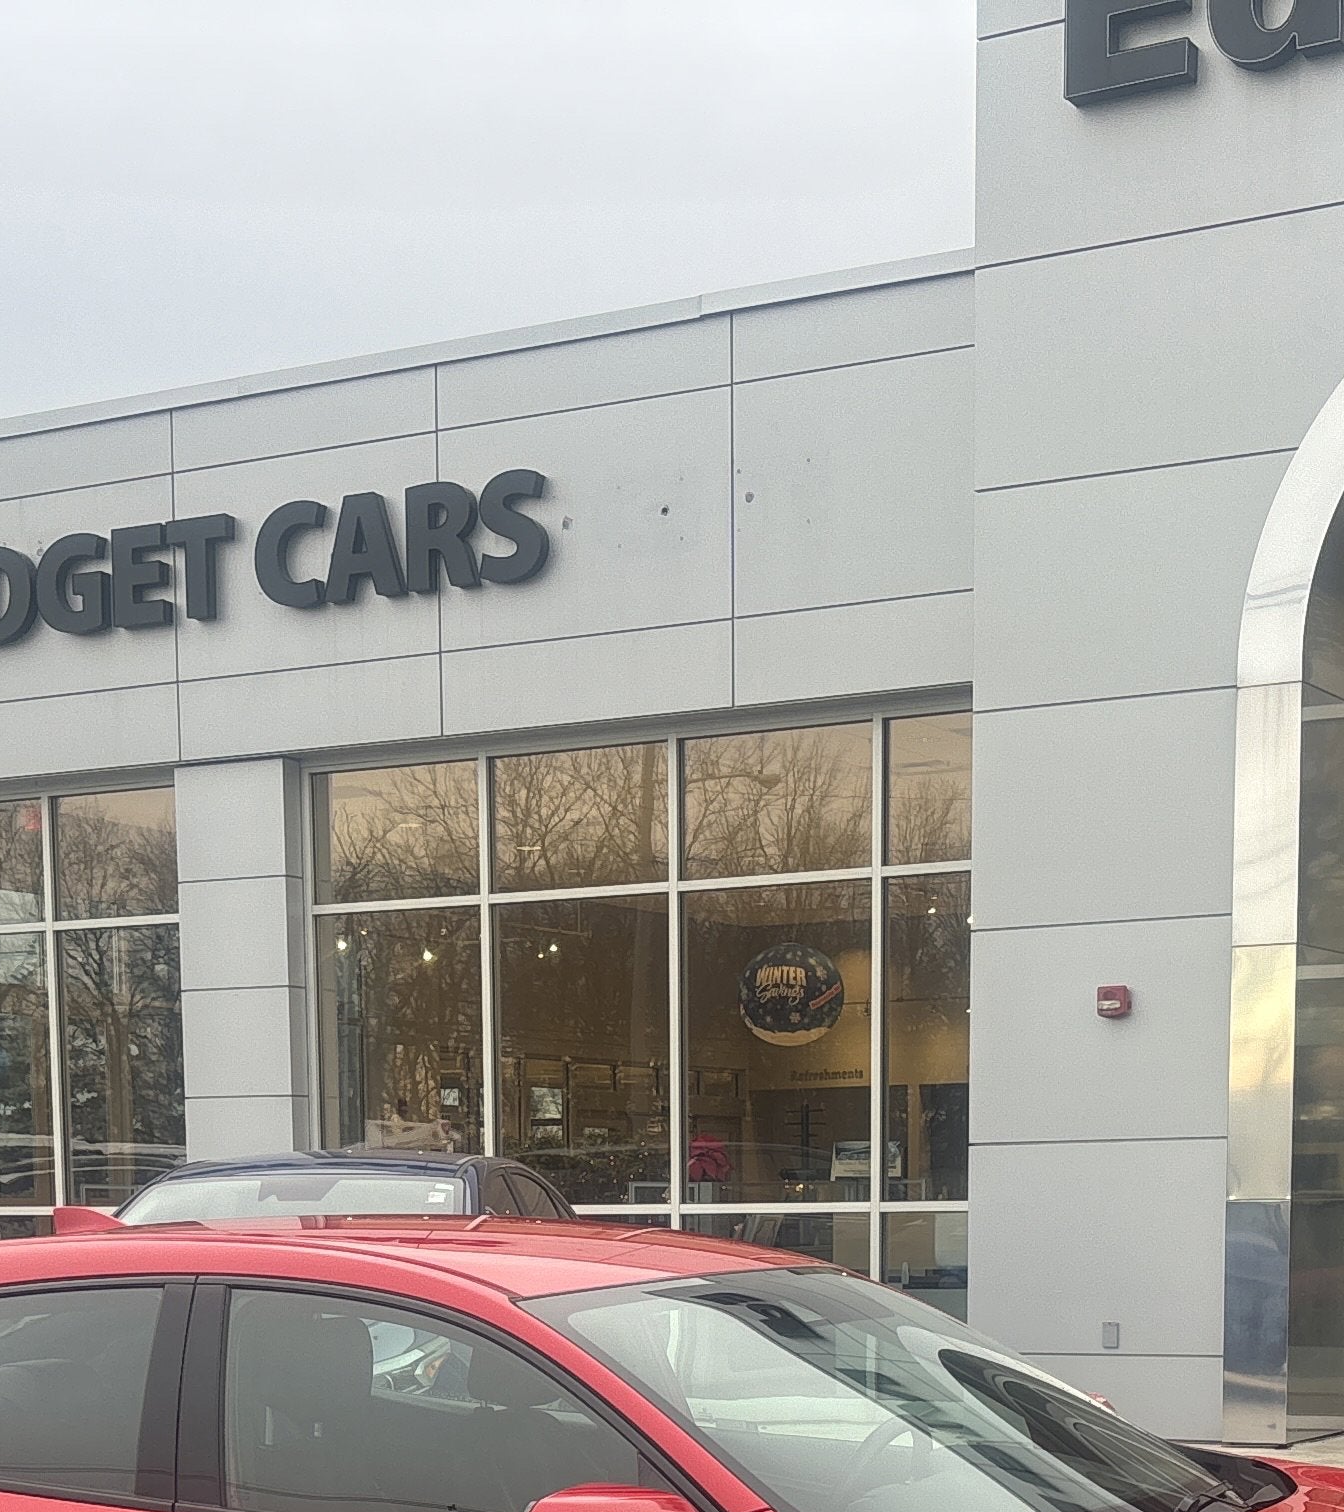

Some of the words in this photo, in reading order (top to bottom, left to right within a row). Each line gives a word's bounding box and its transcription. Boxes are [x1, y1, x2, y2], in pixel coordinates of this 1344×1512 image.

[254, 468, 550, 609] CARS
[755, 965, 807, 986] WINTER
[790, 1068, 864, 1081] Refreshments
